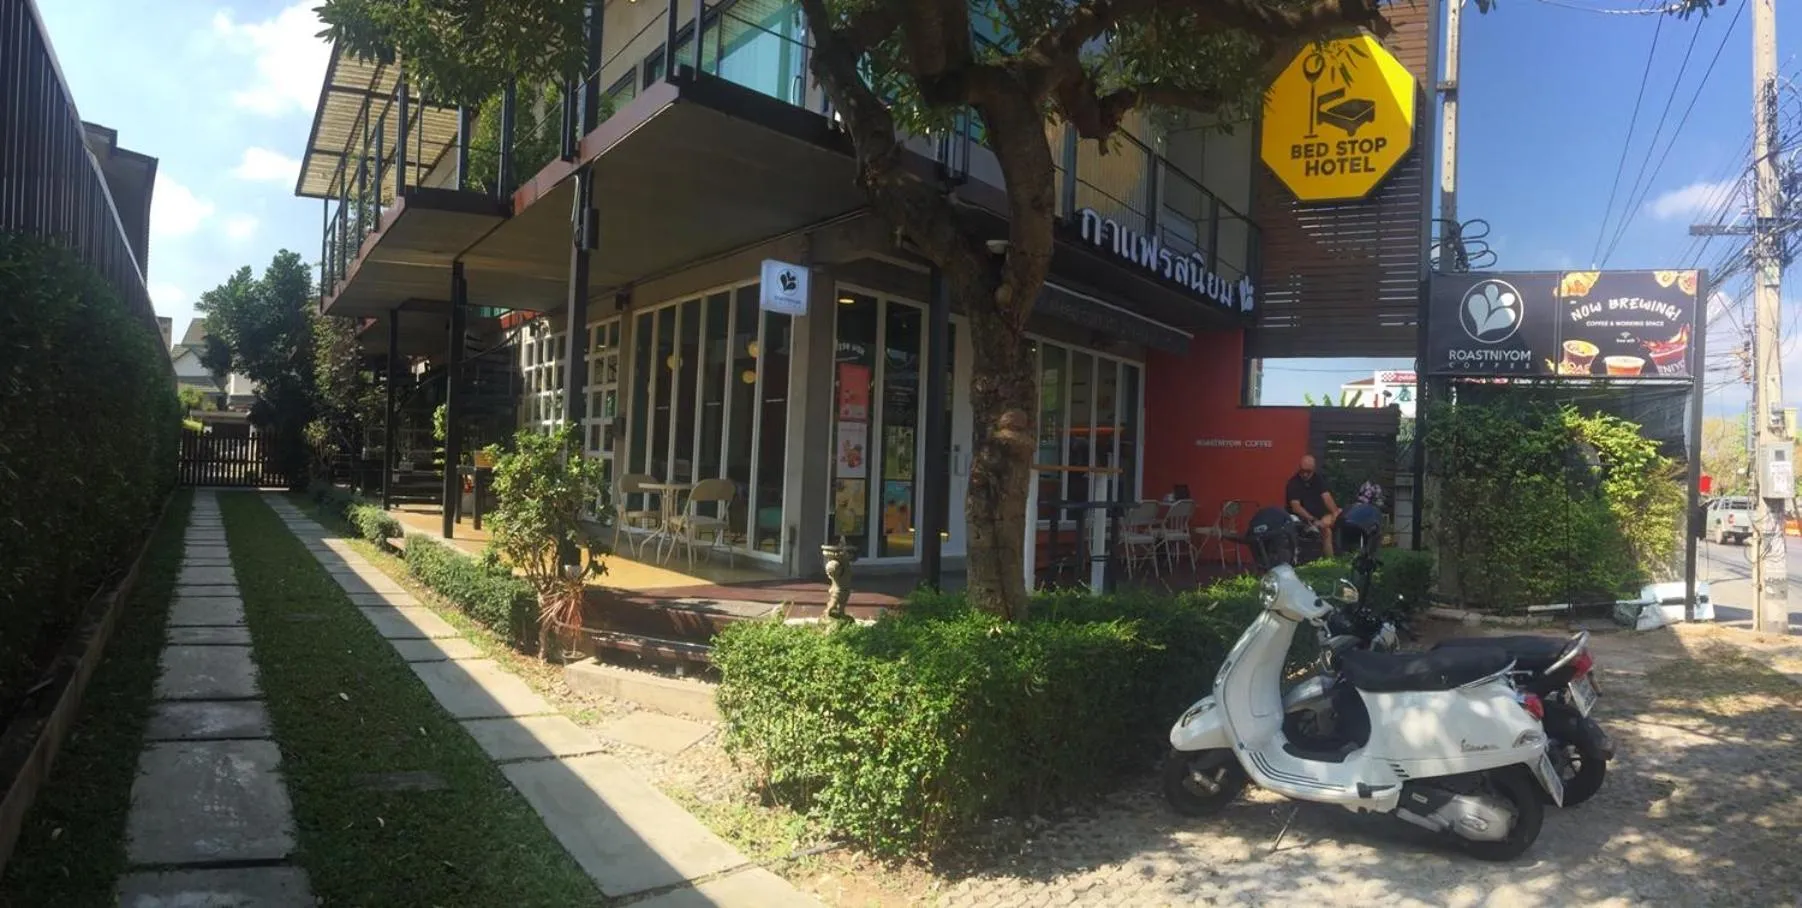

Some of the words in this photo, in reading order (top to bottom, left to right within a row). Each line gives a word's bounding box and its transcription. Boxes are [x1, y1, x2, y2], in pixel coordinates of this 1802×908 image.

[1291, 142, 1328, 160] BED
[1336, 137, 1387, 156] STOP
[1305, 156, 1376, 176] HOTEL
[1570, 301, 1603, 322] NOW
[1608, 297, 1682, 321] BREWING!
[1448, 349, 1532, 361] ROASTNIYOM
